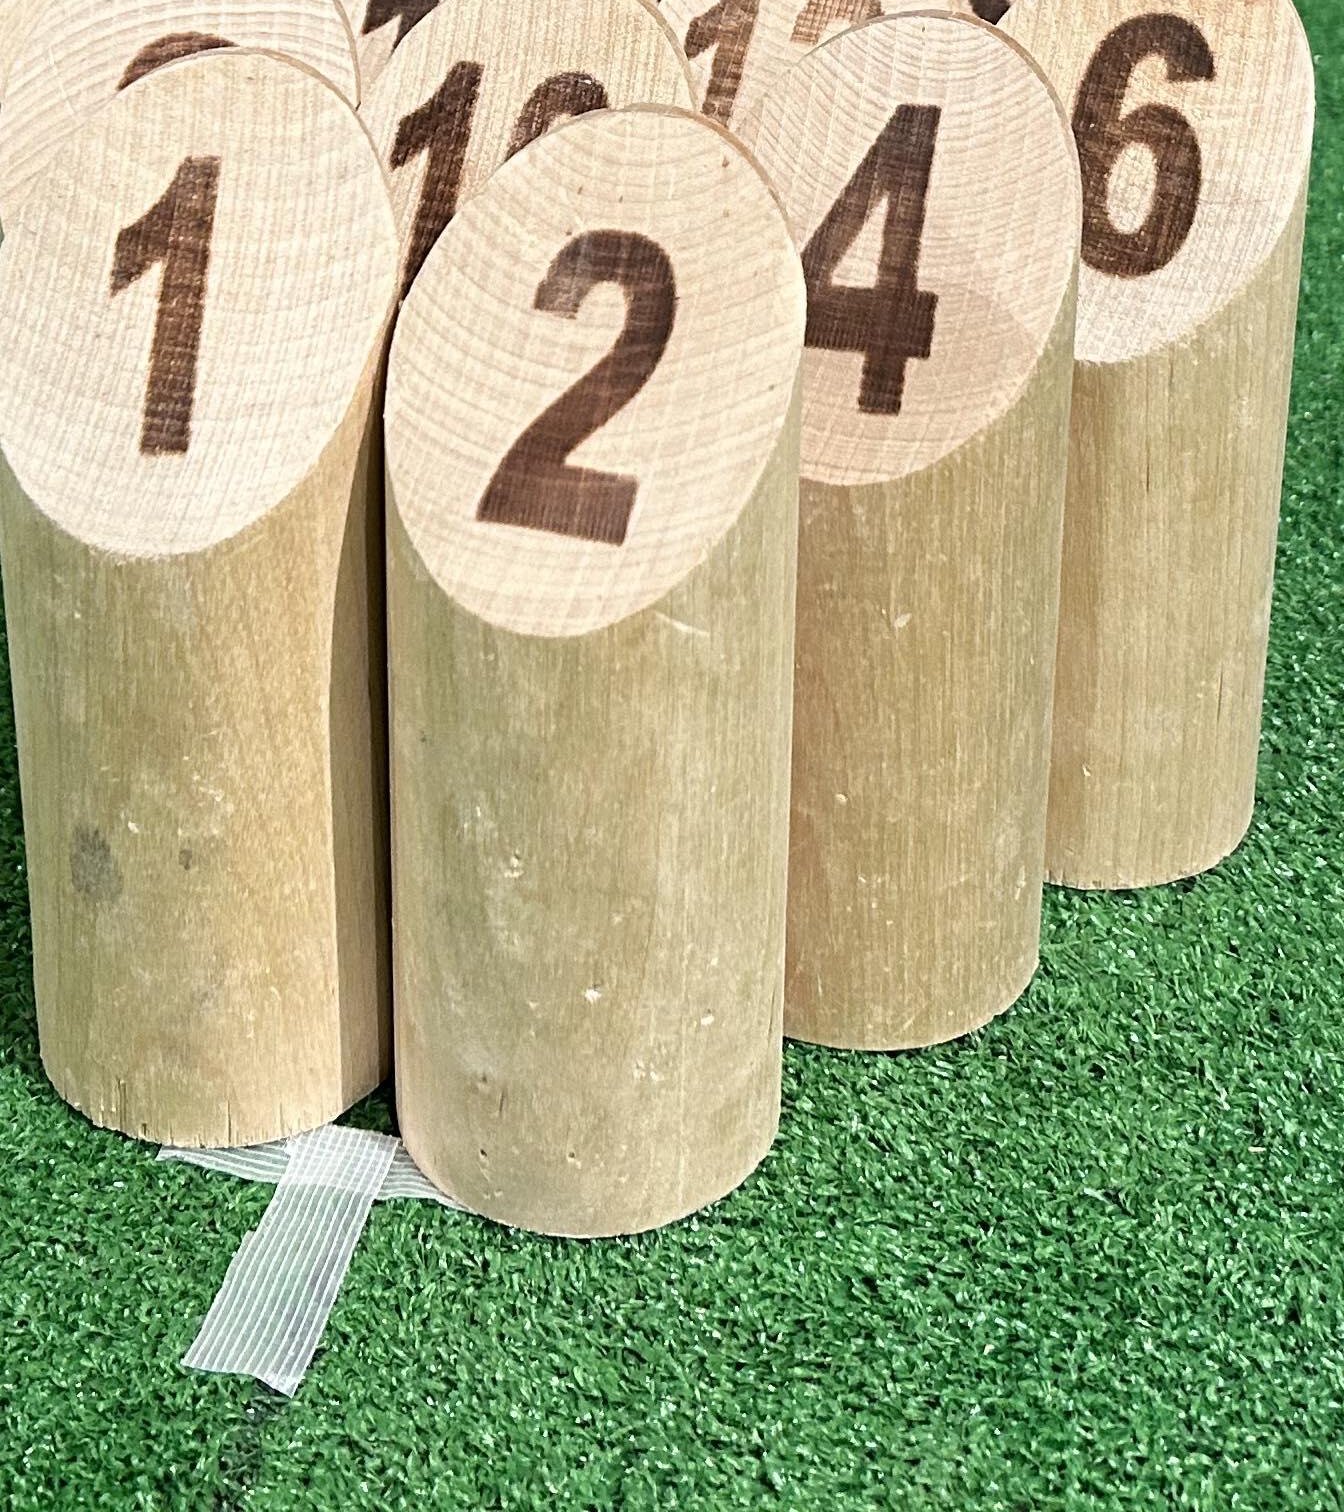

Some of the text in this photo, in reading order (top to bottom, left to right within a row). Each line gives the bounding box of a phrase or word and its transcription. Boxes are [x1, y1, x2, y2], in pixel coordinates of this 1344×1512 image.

[803, 103, 941, 415] 4
[1071, 12, 1217, 279] 6
[109, 155, 221, 456] 1
[476, 229, 676, 546] 2
